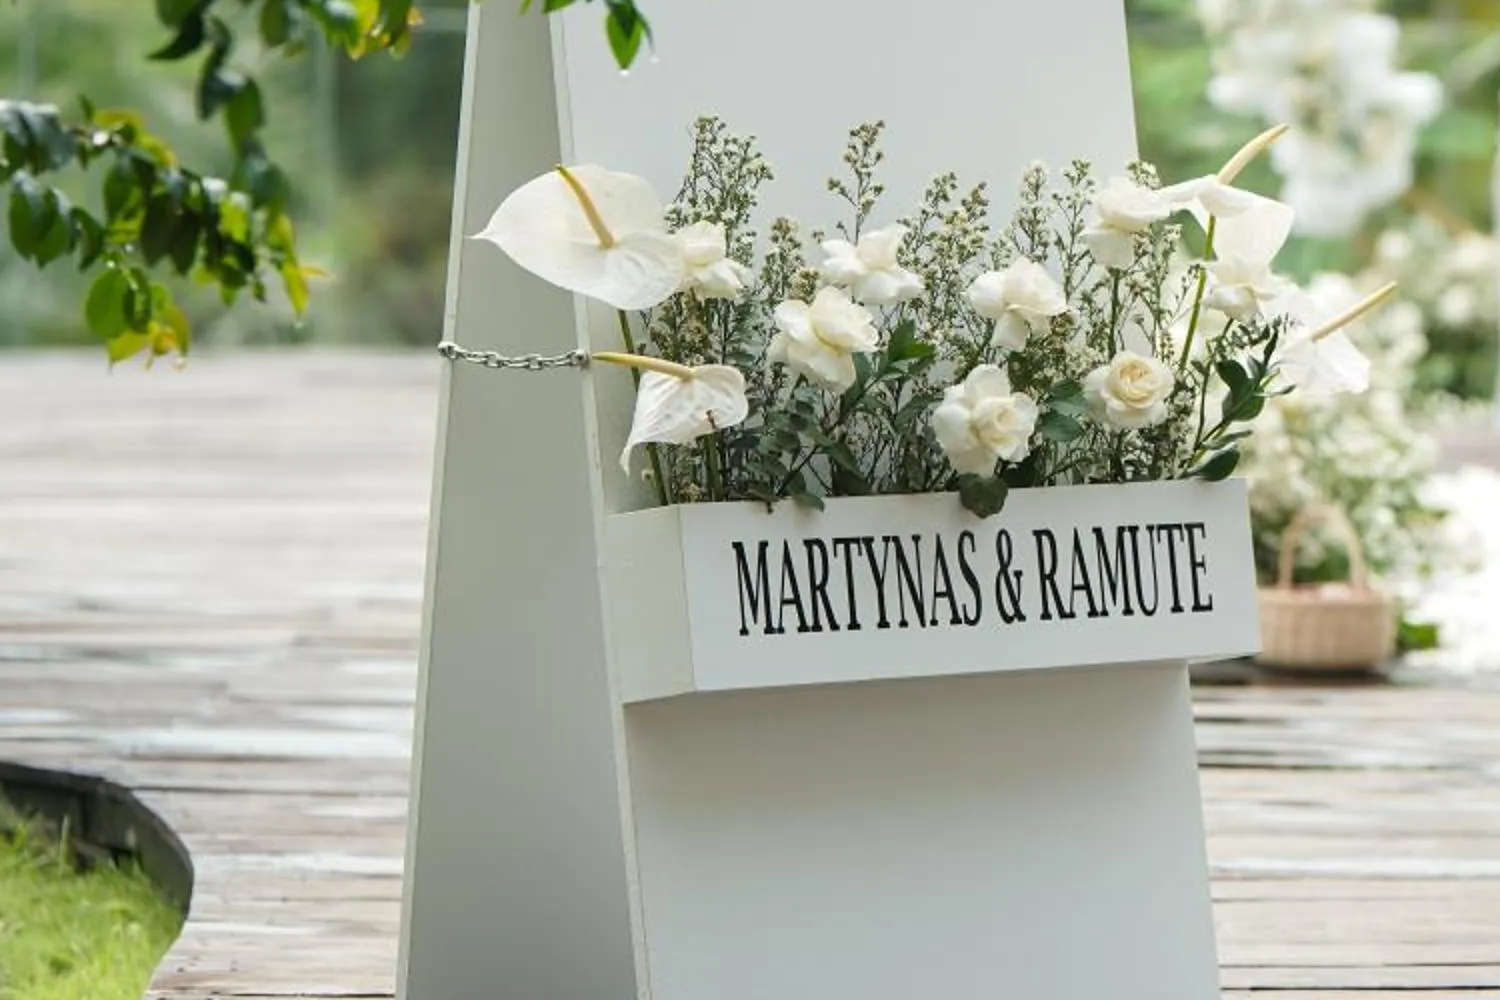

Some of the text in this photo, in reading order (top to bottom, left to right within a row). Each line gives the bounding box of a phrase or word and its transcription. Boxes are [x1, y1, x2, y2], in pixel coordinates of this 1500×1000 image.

[731, 522, 1214, 637] MARTYNAS & RAMUTE
